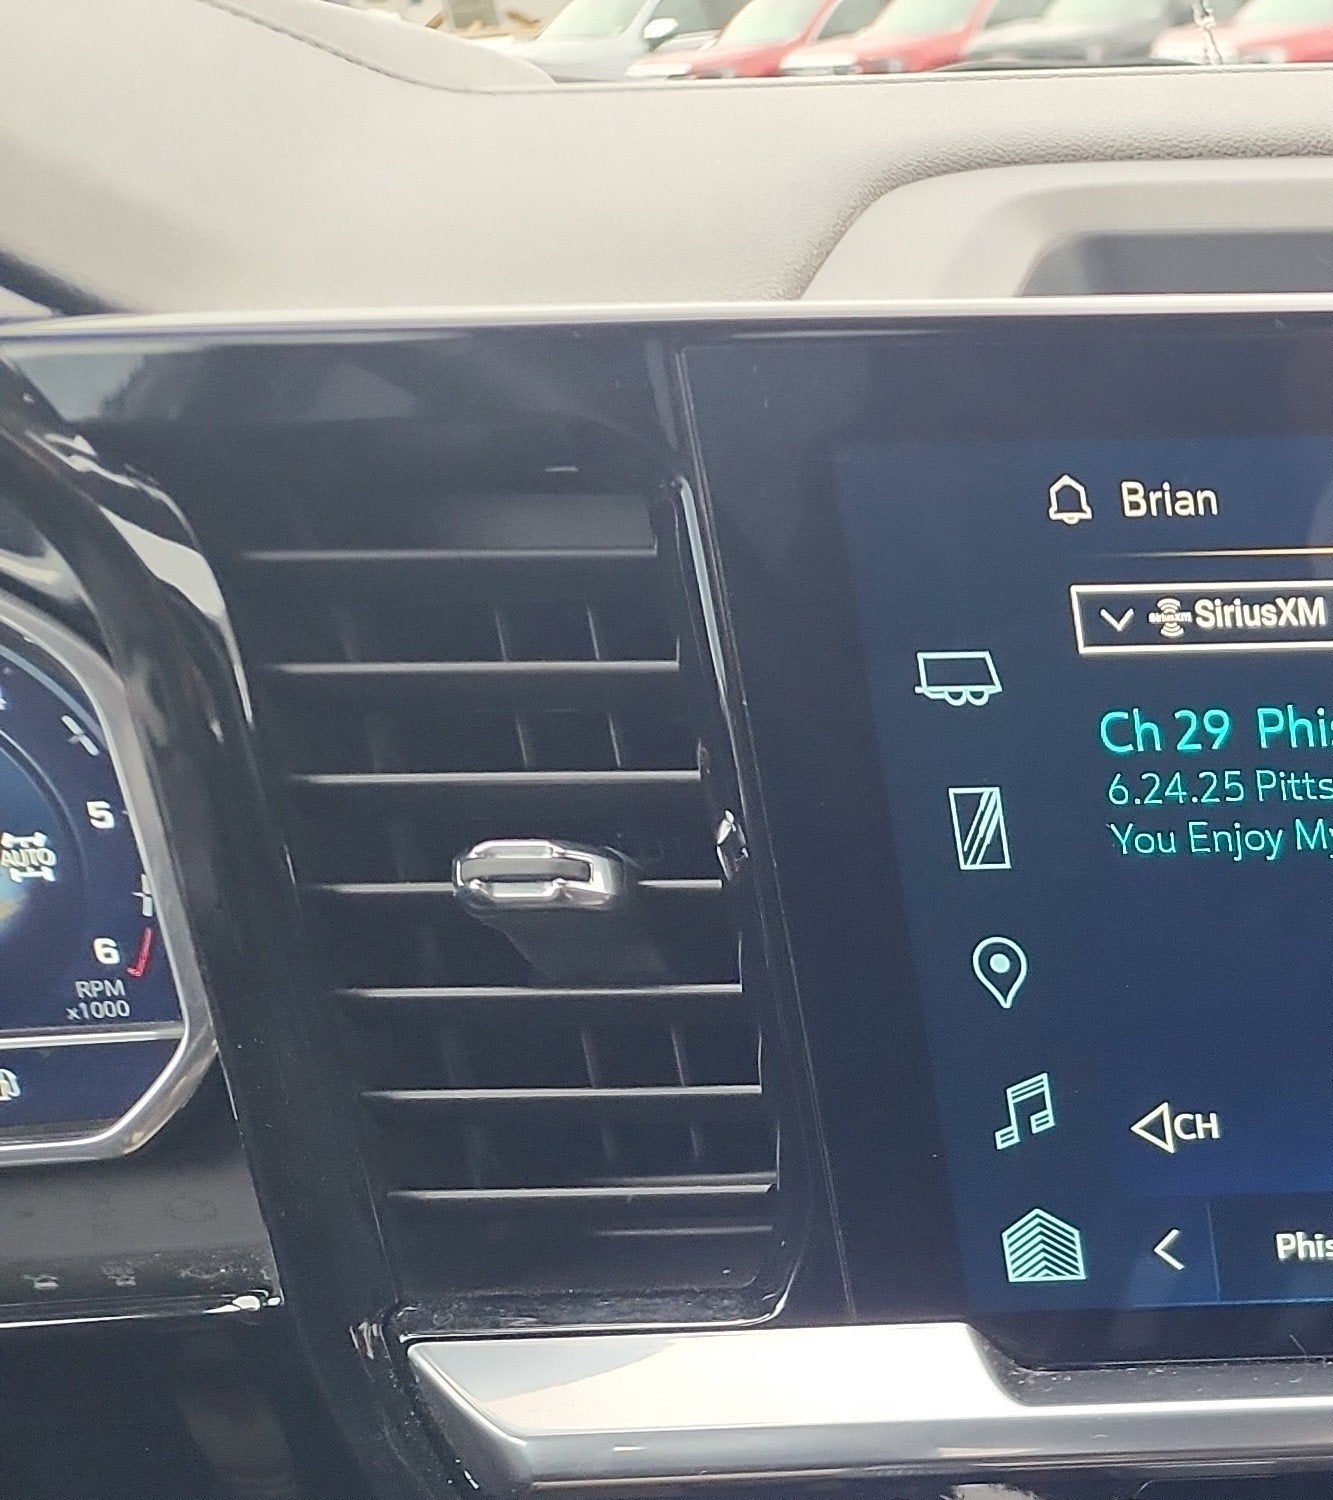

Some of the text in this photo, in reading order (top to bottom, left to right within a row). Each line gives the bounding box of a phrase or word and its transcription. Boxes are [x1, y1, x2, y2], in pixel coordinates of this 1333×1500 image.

[1121, 481, 1218, 517] Brian
[1194, 596, 1327, 629] SiriusXM
[1100, 707, 1163, 754] Ch
[1174, 709, 1230, 751] 29
[1108, 770, 1245, 805] 6.24.25
[86, 800, 115, 830] 5
[1110, 823, 1177, 855] You
[1188, 821, 1284, 862] Enjoy
[1, 847, 56, 868] AUTO
[93, 937, 121, 965] 6
[75, 978, 126, 999] RPM
[66, 999, 130, 1020] x1000
[1173, 1112, 1221, 1141] CH
